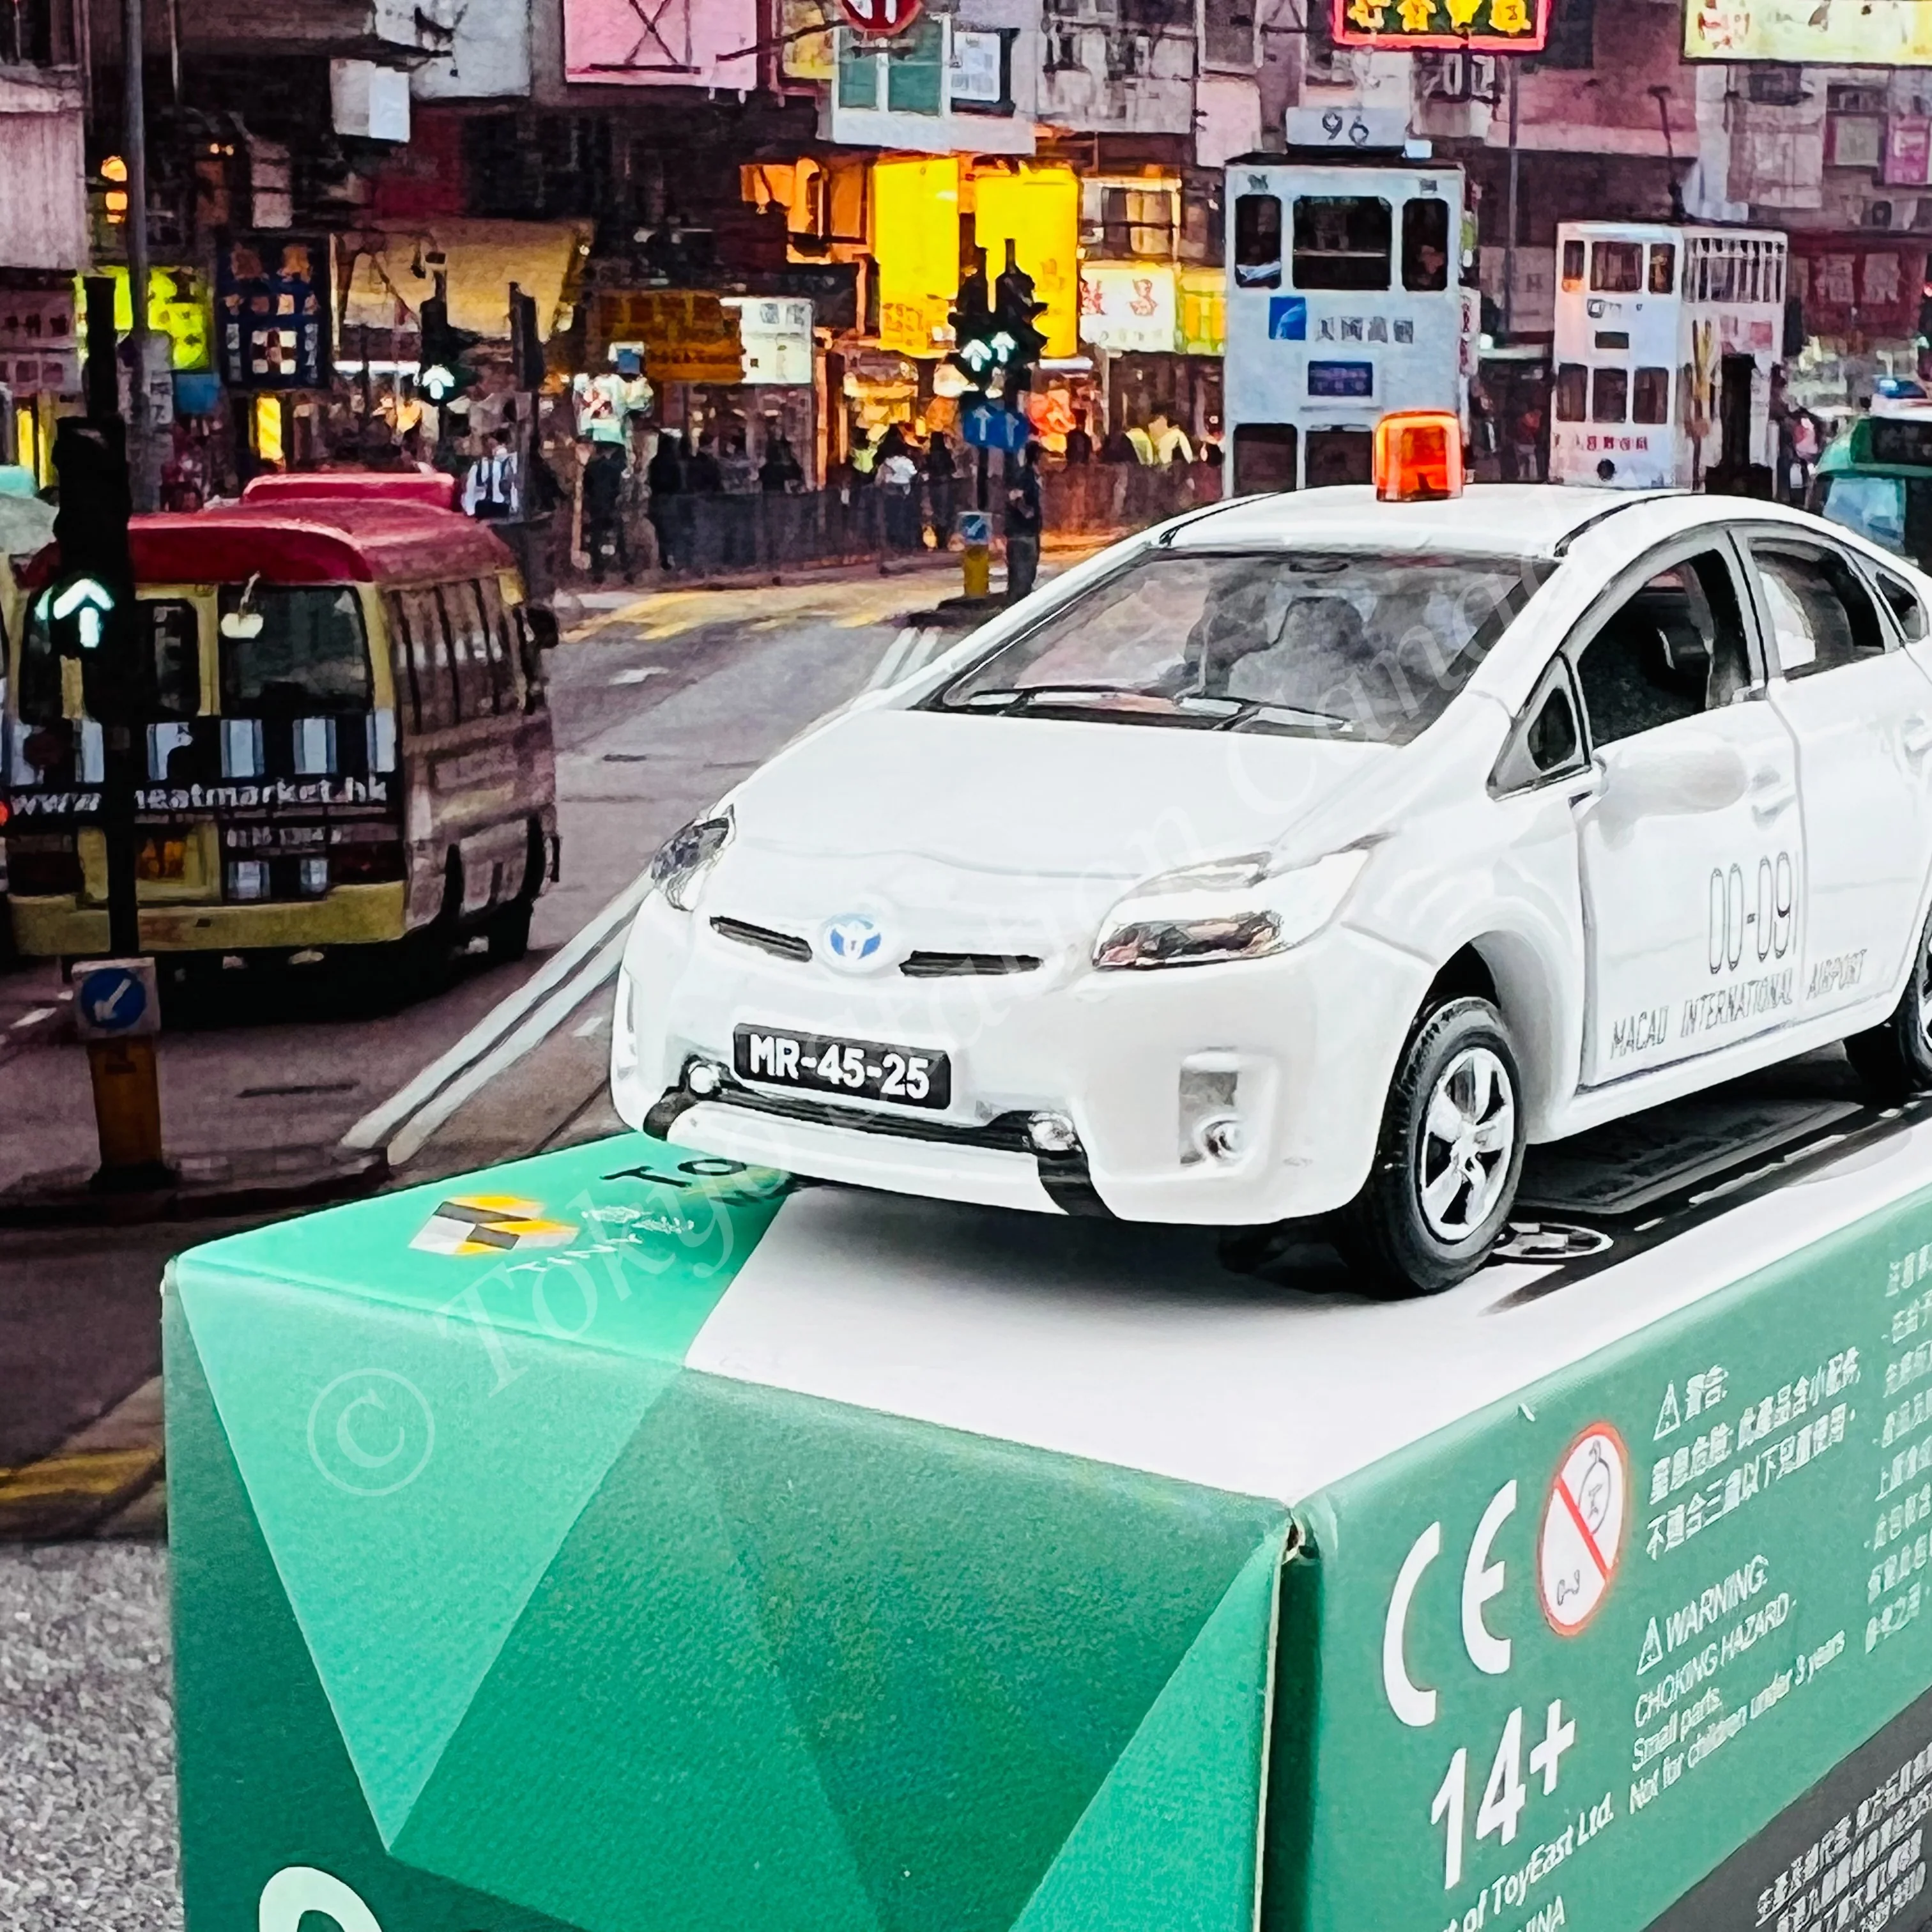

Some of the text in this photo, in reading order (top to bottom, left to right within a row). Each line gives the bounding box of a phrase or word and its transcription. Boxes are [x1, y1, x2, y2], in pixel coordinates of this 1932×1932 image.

[1322, 112, 1369, 149] 96
[1609, 948, 1867, 1060] MACAU INTERNATIONAL AIRPORT
[749, 1034, 930, 1100] MR-45-25
[1383, 1479, 1518, 1727] CE
[1630, 1767, 1660, 1815] Not
[1662, 1751, 1685, 1790] for
[1687, 1705, 1748, 1769] children
[1749, 1667, 1793, 1720] under
[1806, 1629, 1846, 1685] years
[1632, 1709, 1679, 1772] Small
[1634, 1643, 1718, 1728] CHOKING
[1430, 1698, 1576, 1890] 14+
[1491, 1824, 1574, 1915] ToyEast
[1577, 1791, 1614, 1846] Ltd.
